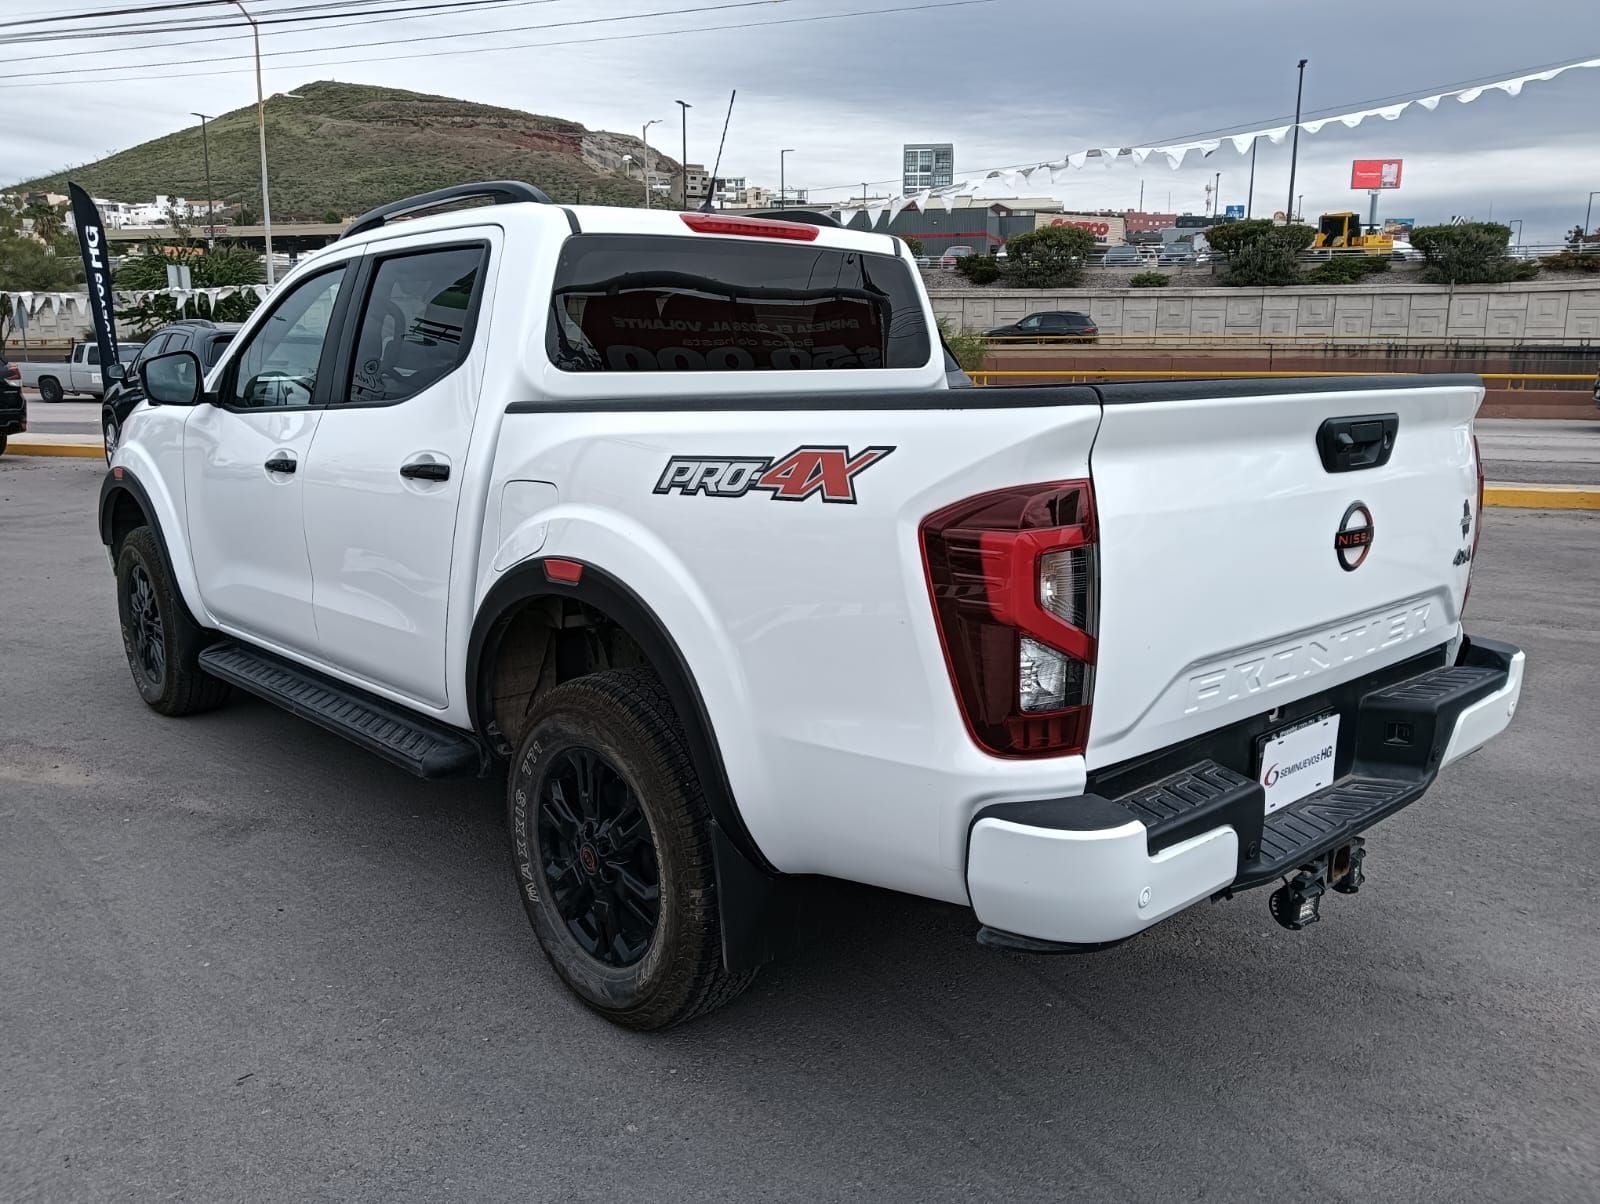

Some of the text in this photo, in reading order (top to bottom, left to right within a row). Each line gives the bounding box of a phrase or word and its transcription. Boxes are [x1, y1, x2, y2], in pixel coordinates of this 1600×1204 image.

[85, 225, 103, 269] HG
[1184, 602, 1431, 714] FRONTIER
[1280, 745, 1333, 778] SEMINUEVOS HG
